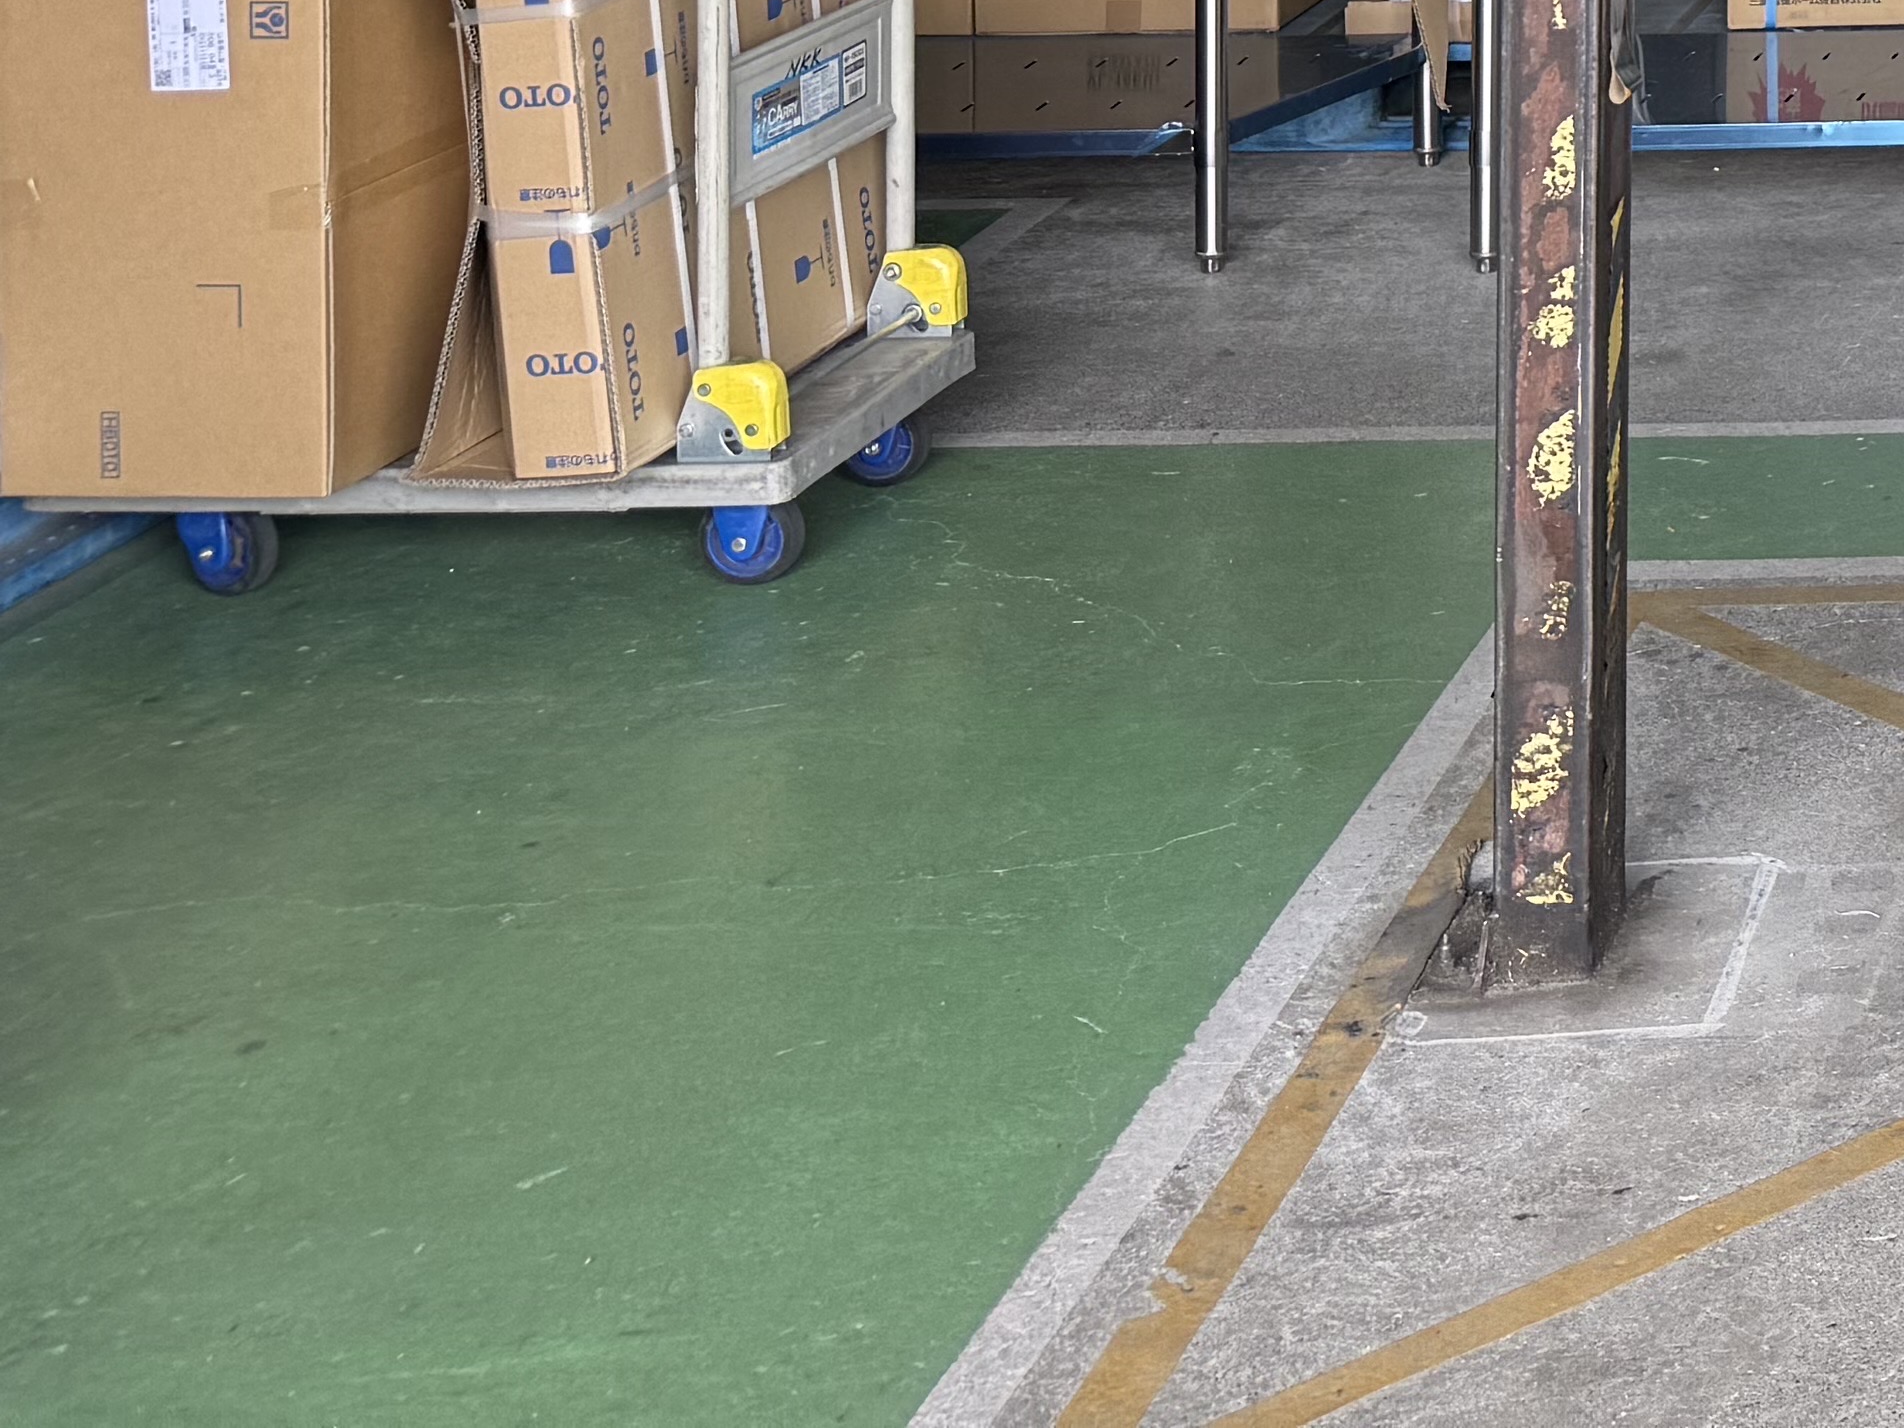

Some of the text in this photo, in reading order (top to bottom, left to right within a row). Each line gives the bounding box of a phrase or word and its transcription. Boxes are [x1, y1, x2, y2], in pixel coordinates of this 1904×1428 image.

[500, 82, 578, 109] OTO
[592, 36, 613, 136] TOTO
[768, 101, 799, 124] CARRY
[526, 351, 606, 378] OTO
[623, 322, 646, 421] TOTO
